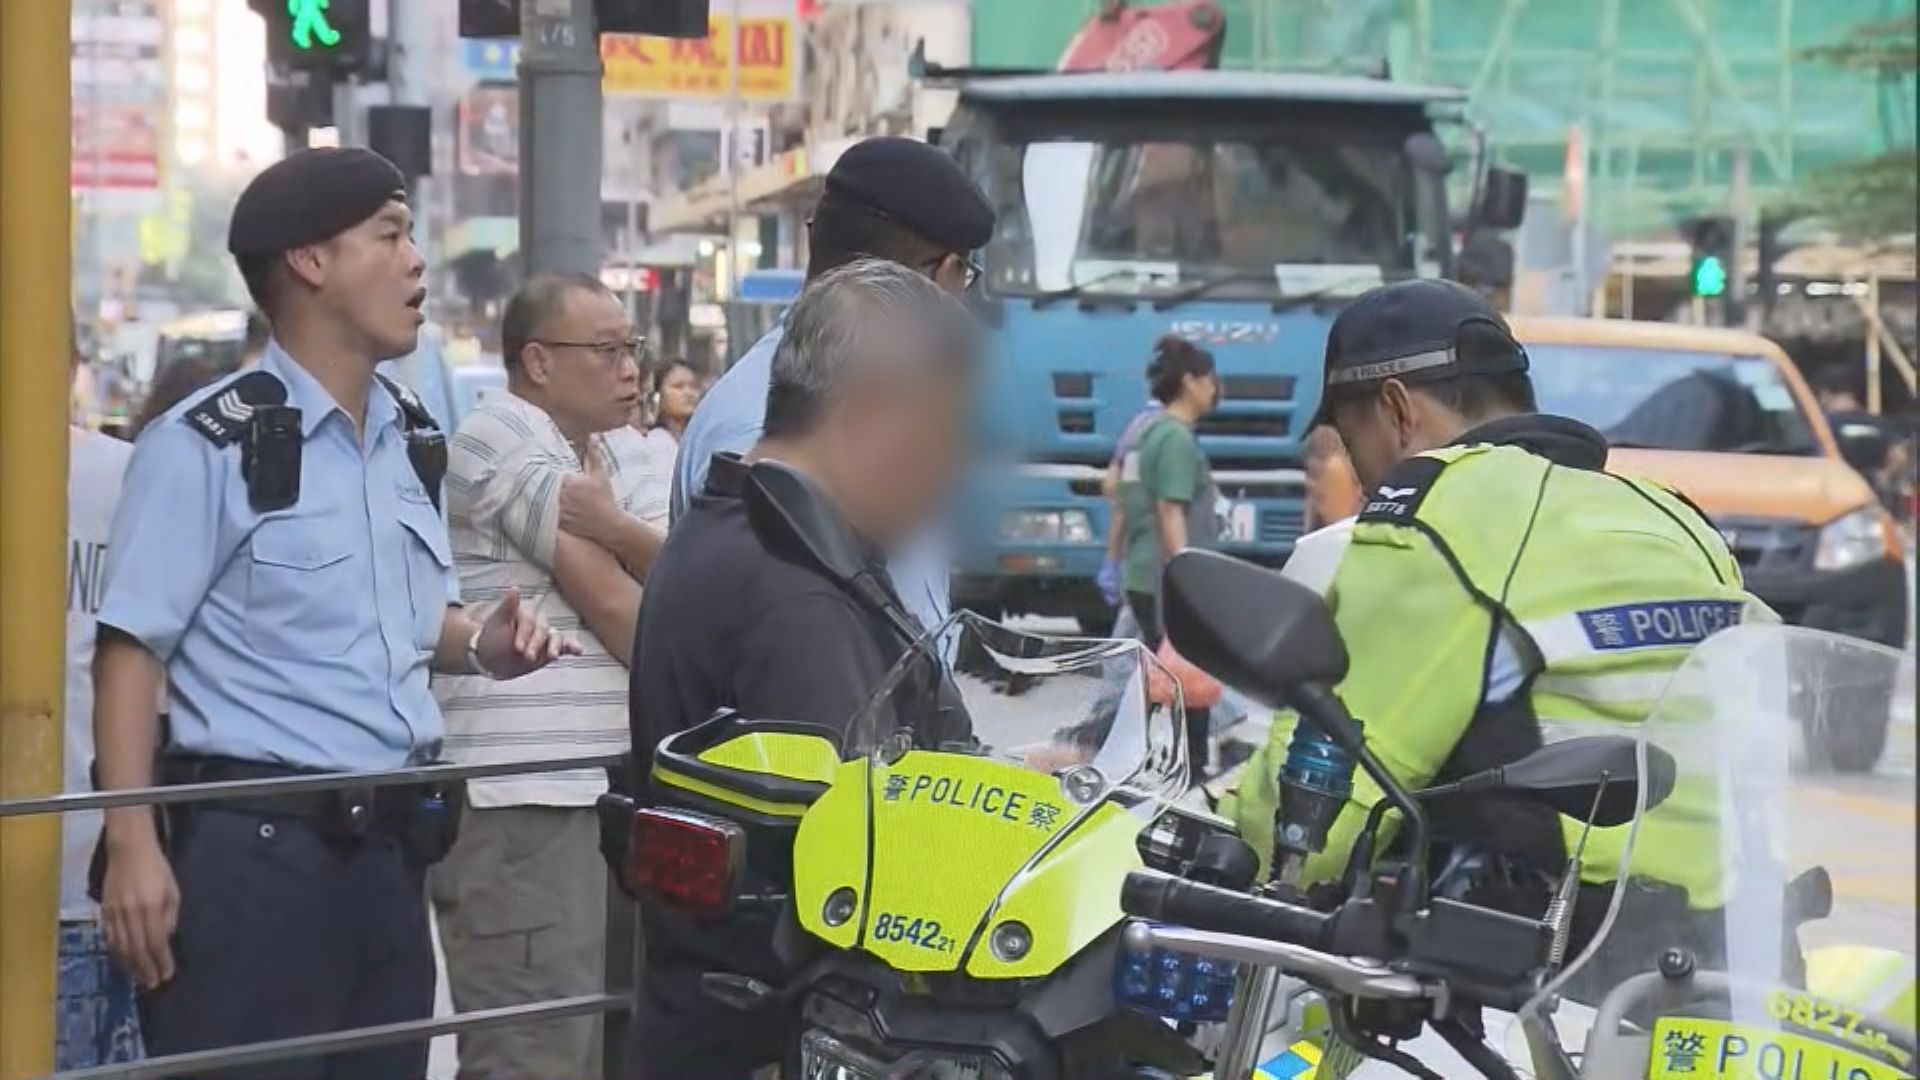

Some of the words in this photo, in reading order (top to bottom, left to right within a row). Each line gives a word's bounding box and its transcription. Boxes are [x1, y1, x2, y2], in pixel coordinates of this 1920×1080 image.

[1171, 321, 1278, 341] ISUZU
[1629, 605, 1726, 641] POLICE
[911, 775, 1027, 821] POLICE
[1028, 801, 1062, 831] 察
[874, 913, 941, 949] 8542
[1664, 1030, 1705, 1072] 警
